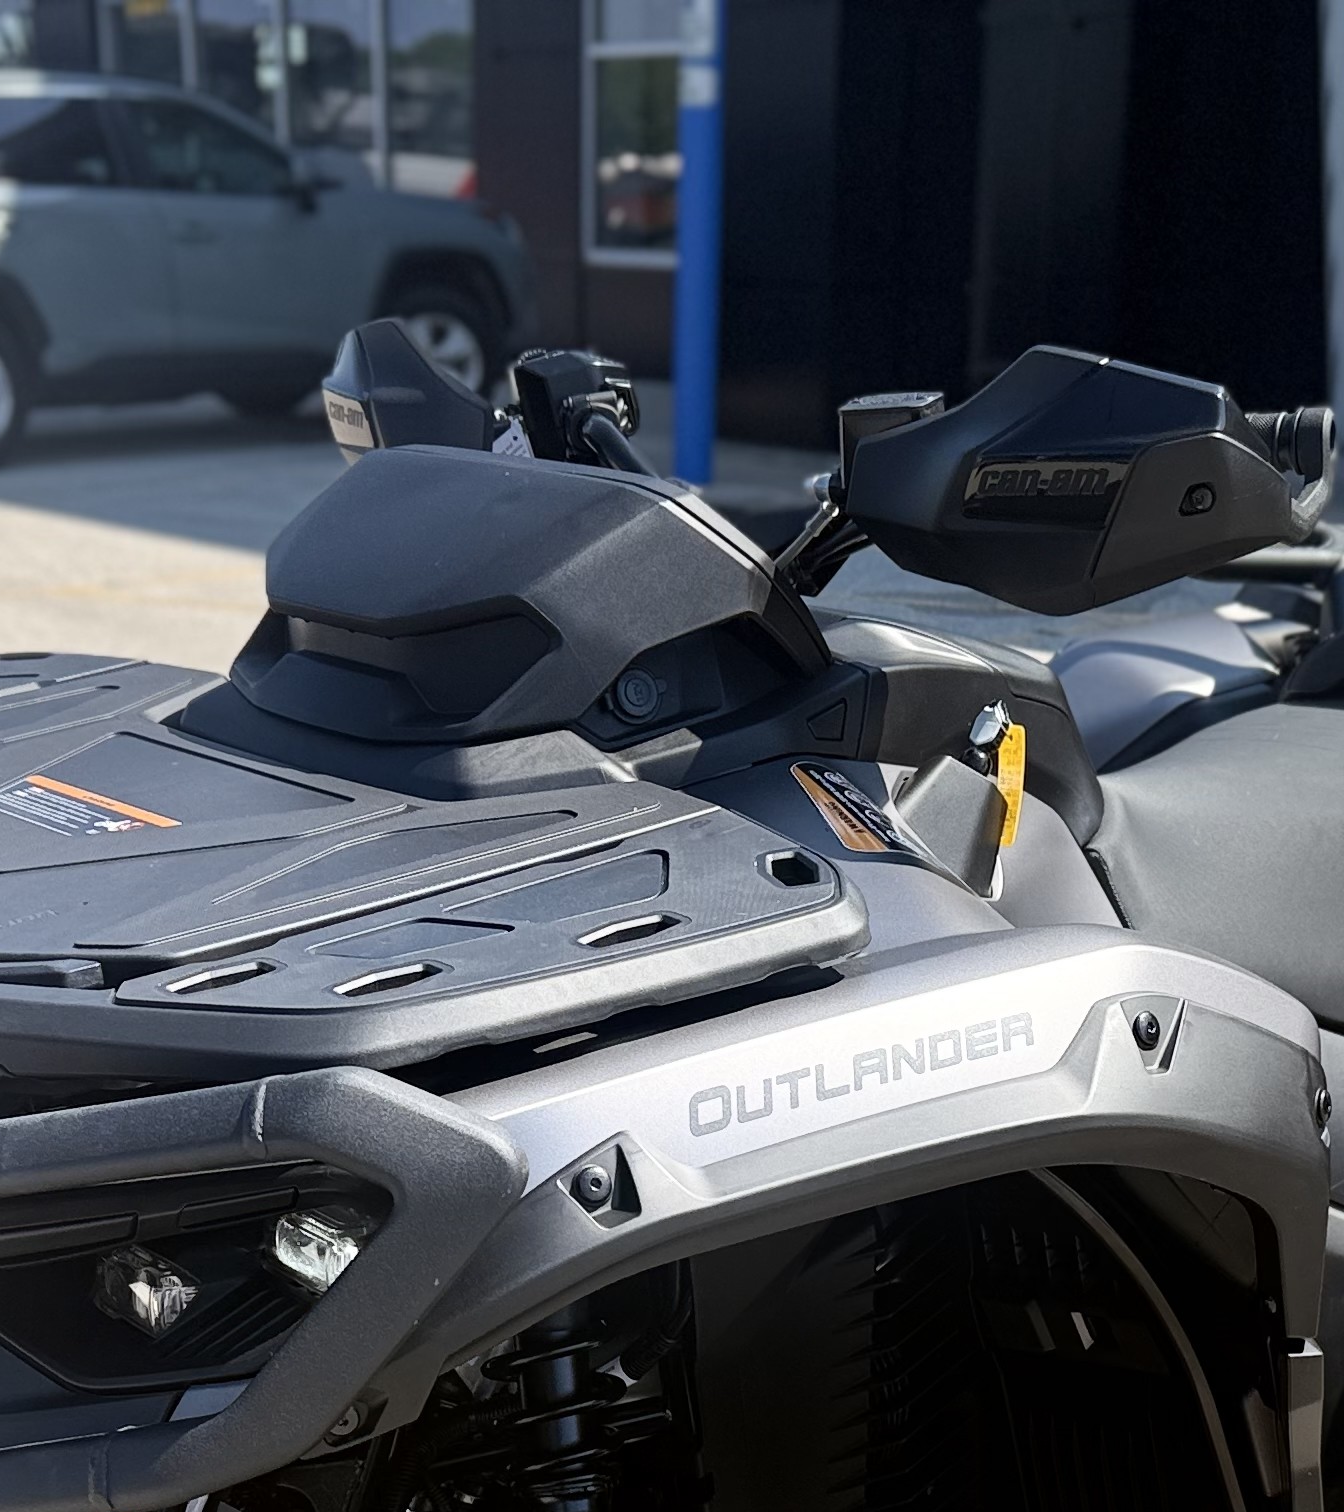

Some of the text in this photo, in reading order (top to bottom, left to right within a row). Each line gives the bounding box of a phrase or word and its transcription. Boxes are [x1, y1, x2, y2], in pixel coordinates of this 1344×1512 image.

[329, 401, 363, 428] can-am
[976, 468, 1110, 497] can-am
[689, 1012, 1035, 1137] OUTLANDER
